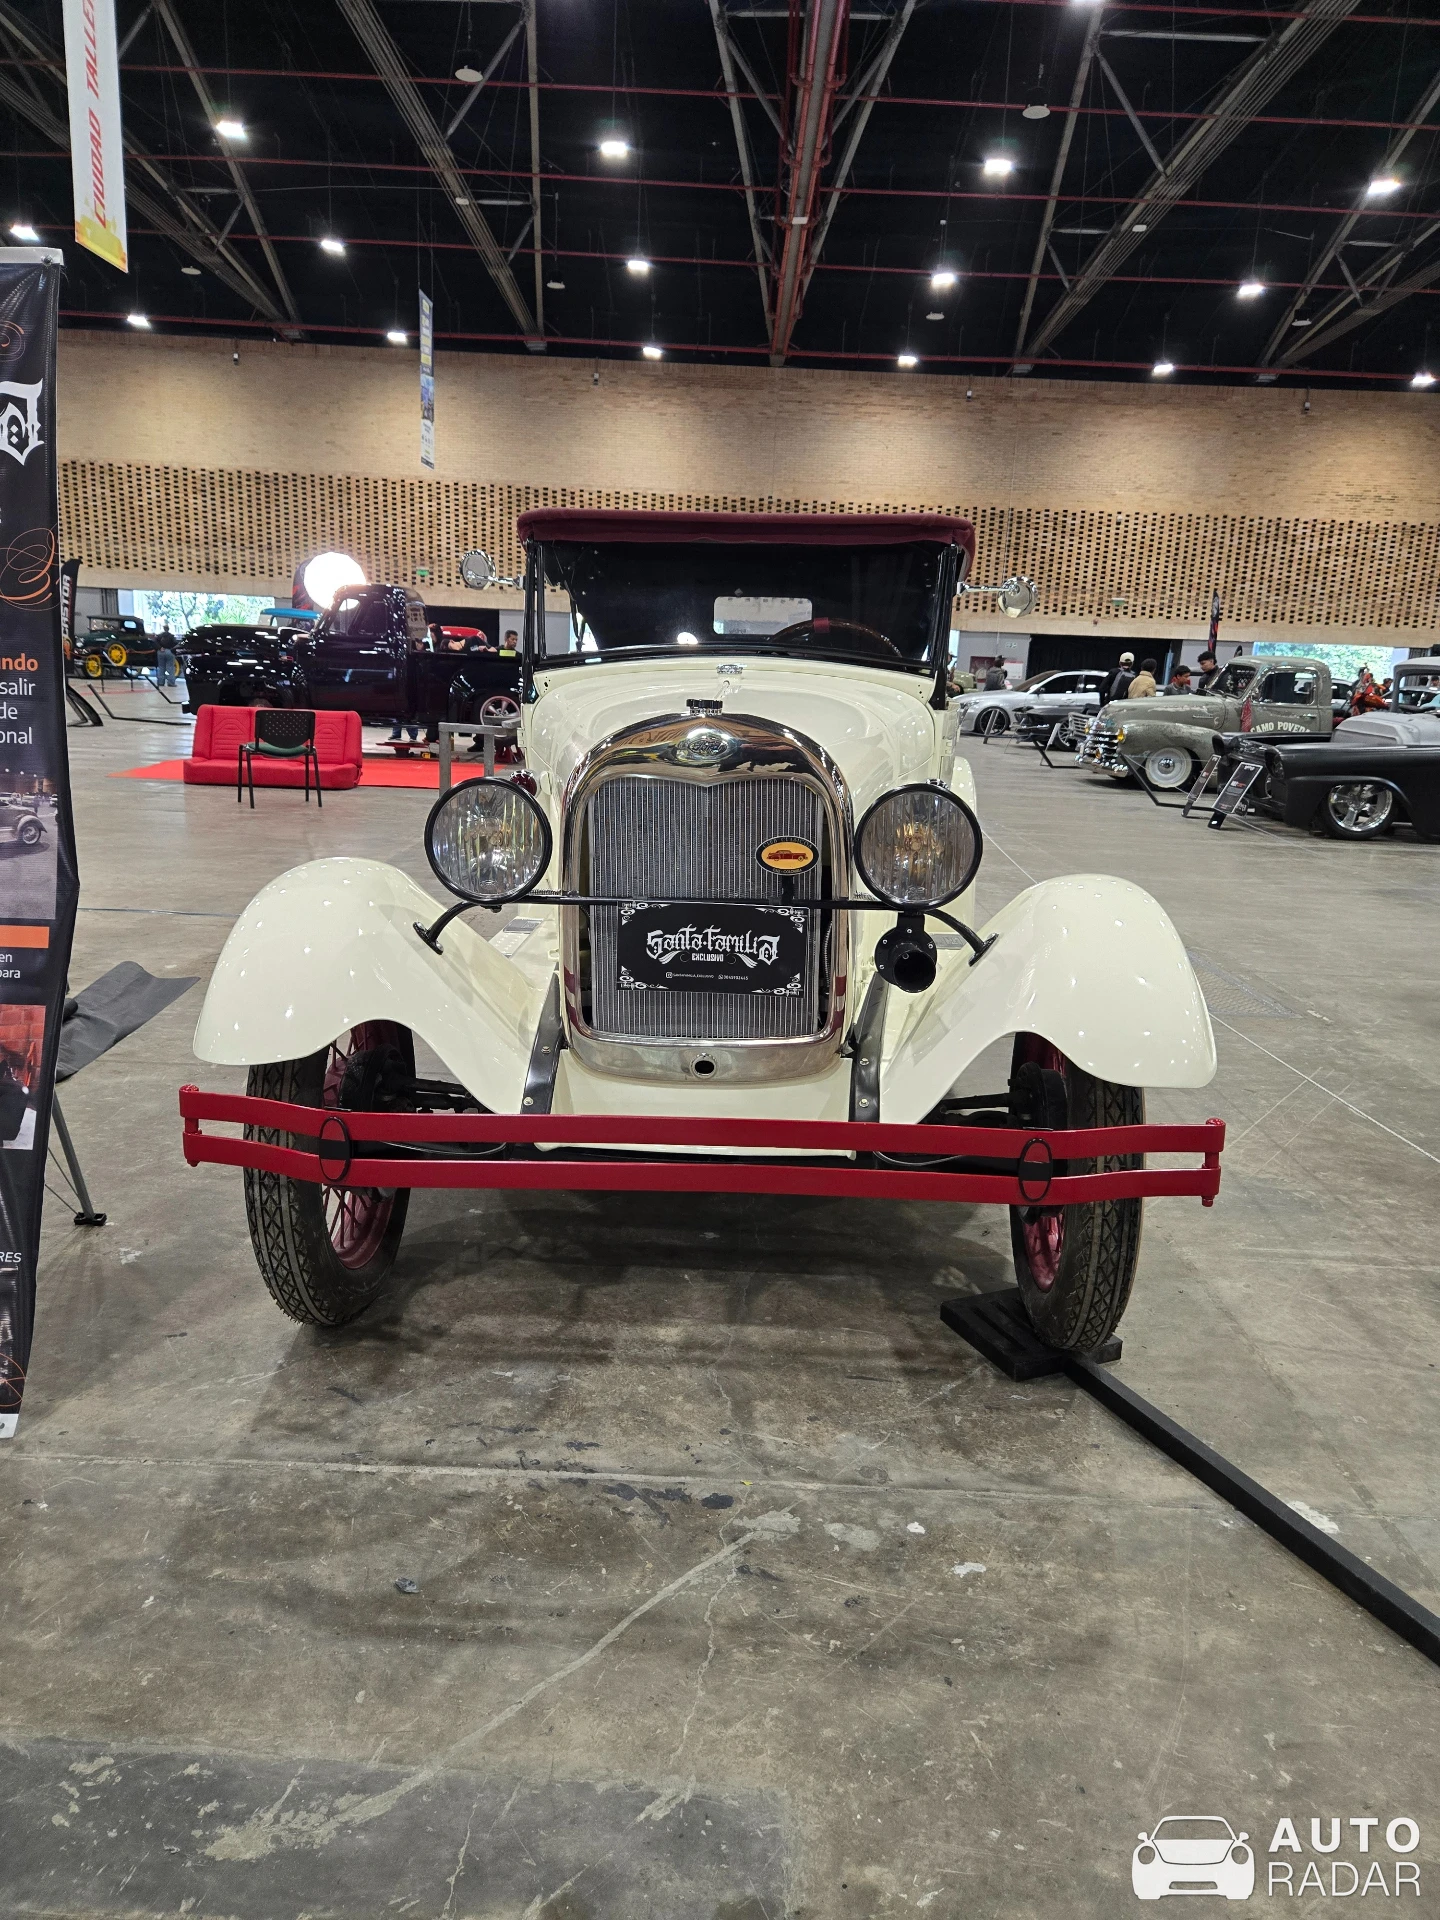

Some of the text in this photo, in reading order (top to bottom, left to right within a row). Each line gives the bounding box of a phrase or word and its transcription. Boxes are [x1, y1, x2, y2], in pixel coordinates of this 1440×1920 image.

[88, 107, 107, 229] CIUDAD
[61, 574, 71, 635] CASTOR
[0, 653, 39, 671] ndo
[0, 677, 36, 695] salir
[0, 701, 18, 720] de
[691, 952, 724, 962] EXCLUSIVO
